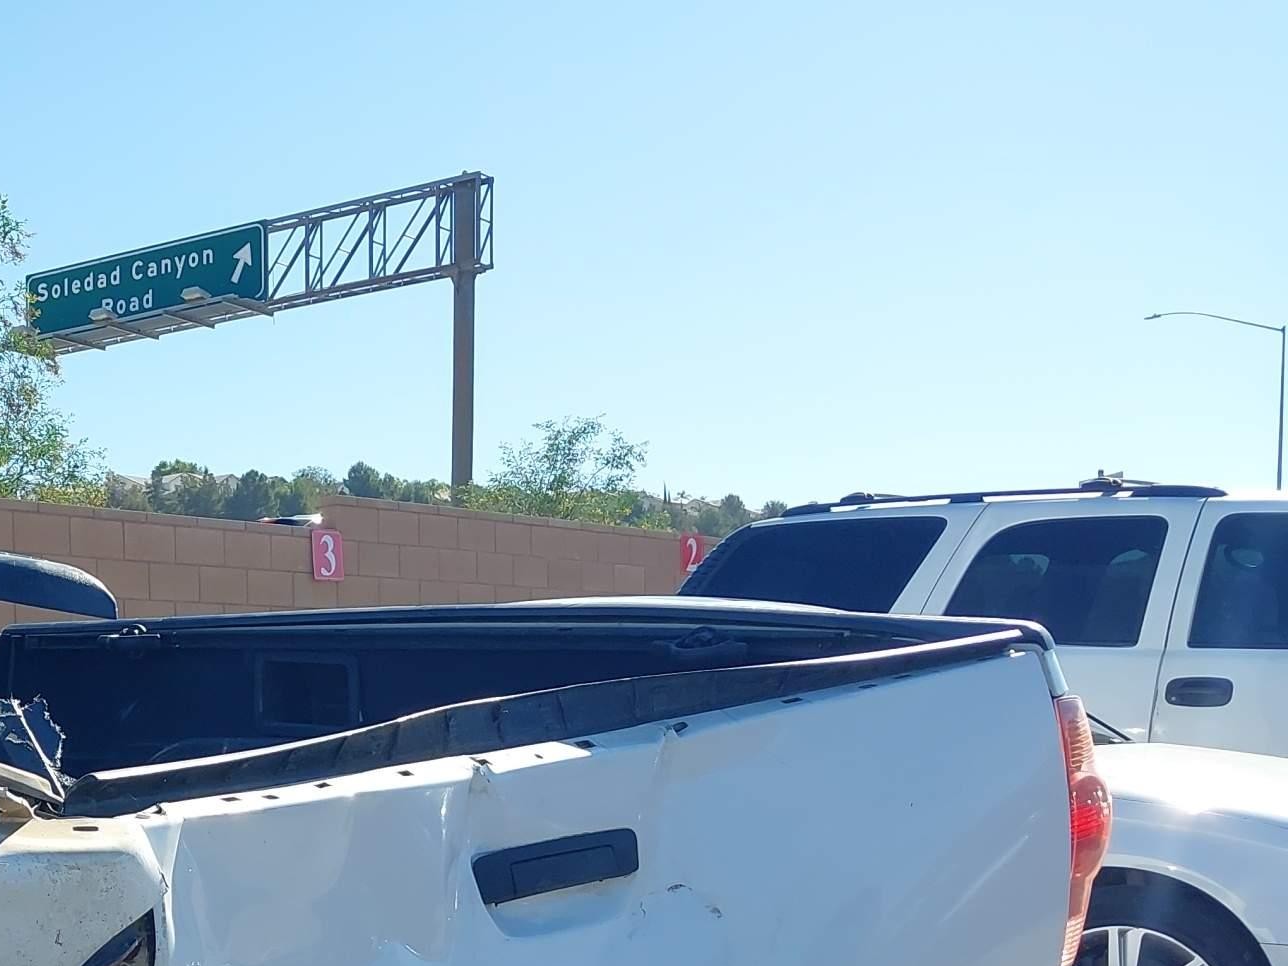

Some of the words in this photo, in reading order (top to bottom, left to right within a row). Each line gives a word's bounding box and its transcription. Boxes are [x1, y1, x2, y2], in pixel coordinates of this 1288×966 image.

[37, 265, 121, 302] Soledad
[131, 248, 214, 280] Canyon
[101, 289, 153, 316] Road
[320, 534, 336, 576] 3
[686, 537, 703, 571] 2
